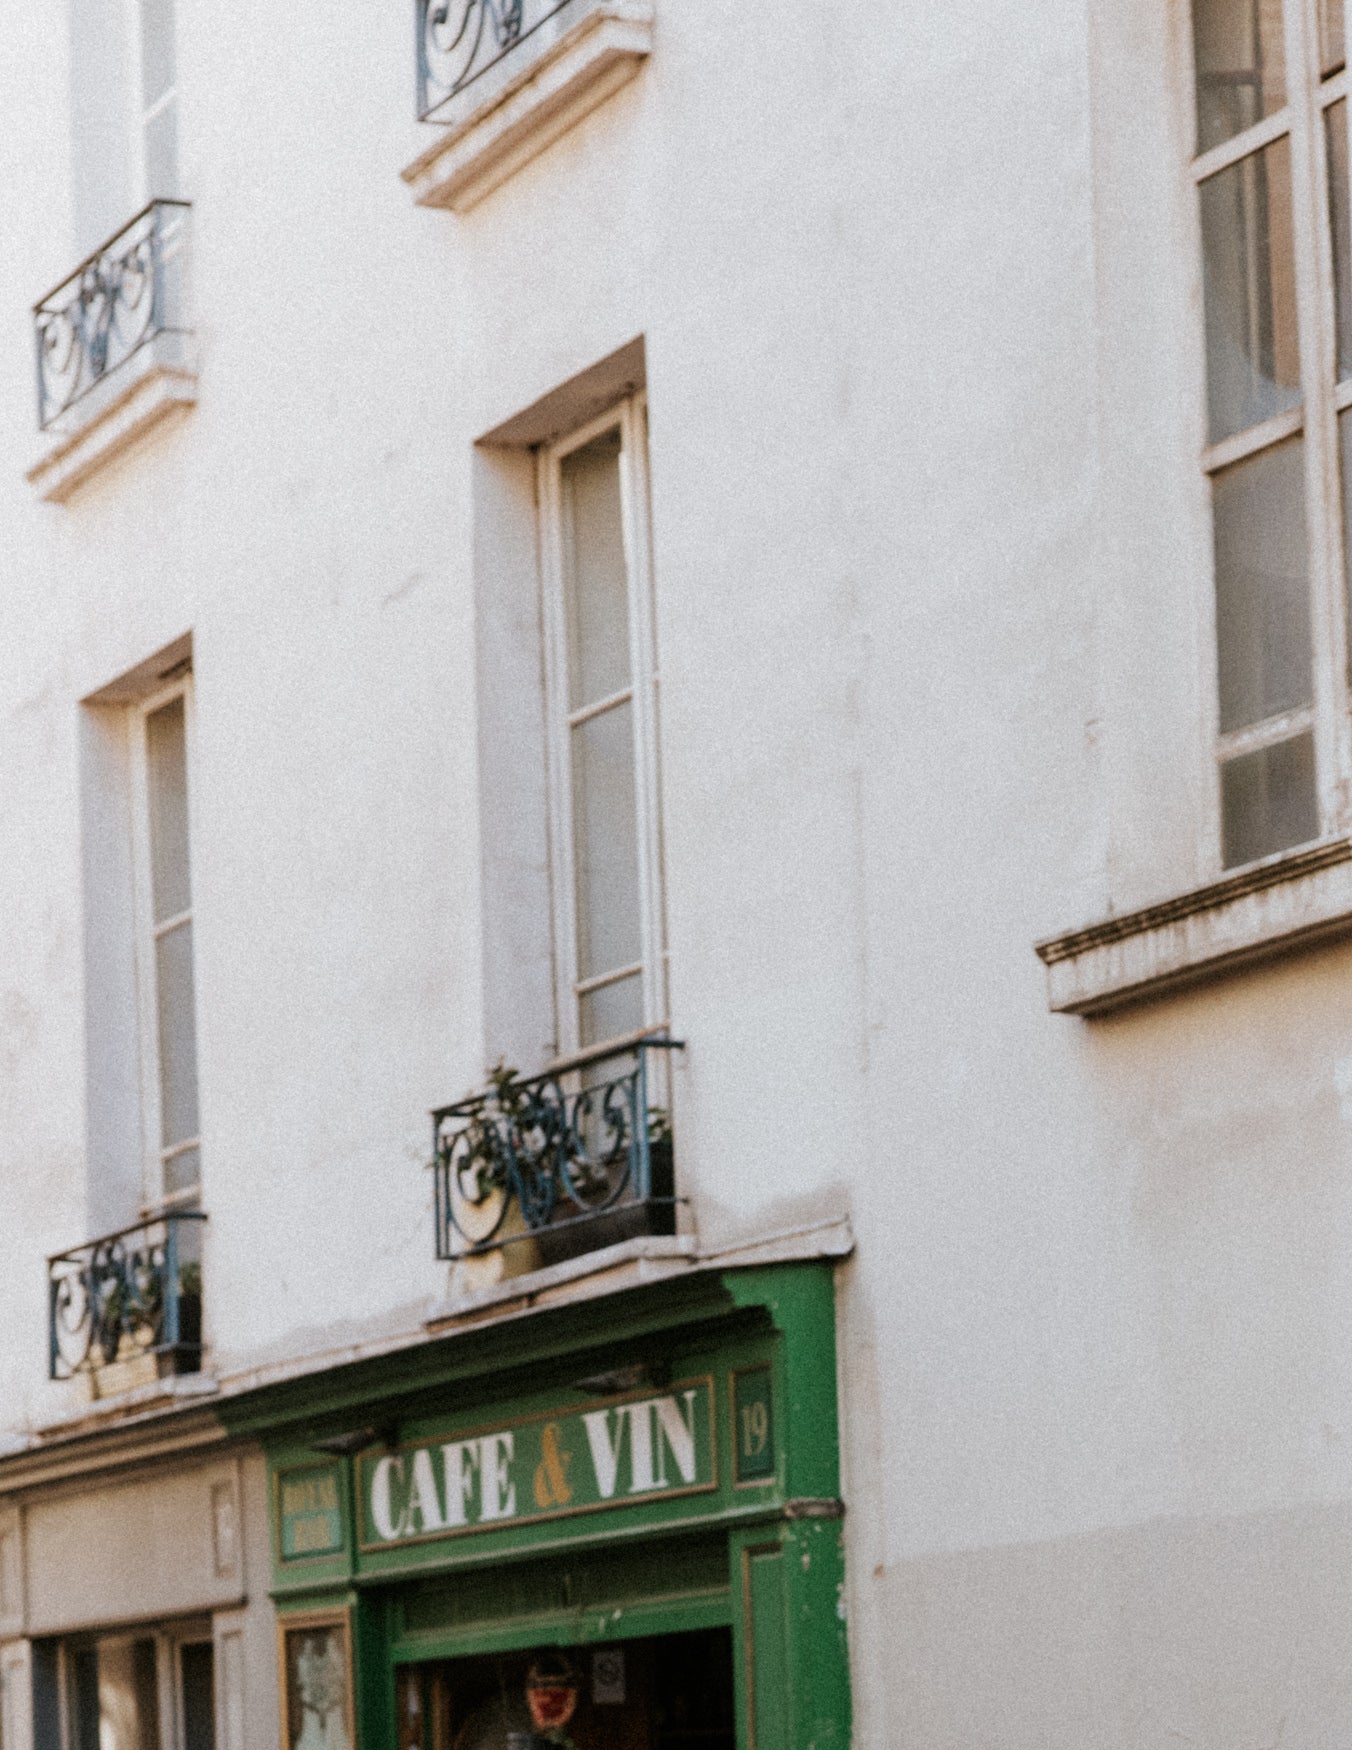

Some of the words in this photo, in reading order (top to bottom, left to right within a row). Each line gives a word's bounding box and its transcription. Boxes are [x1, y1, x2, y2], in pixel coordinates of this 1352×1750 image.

[371, 1431, 516, 1541] CAFE
[532, 1421, 573, 1509] &
[581, 1390, 697, 1499] VIN
[742, 1401, 768, 1457] 19
